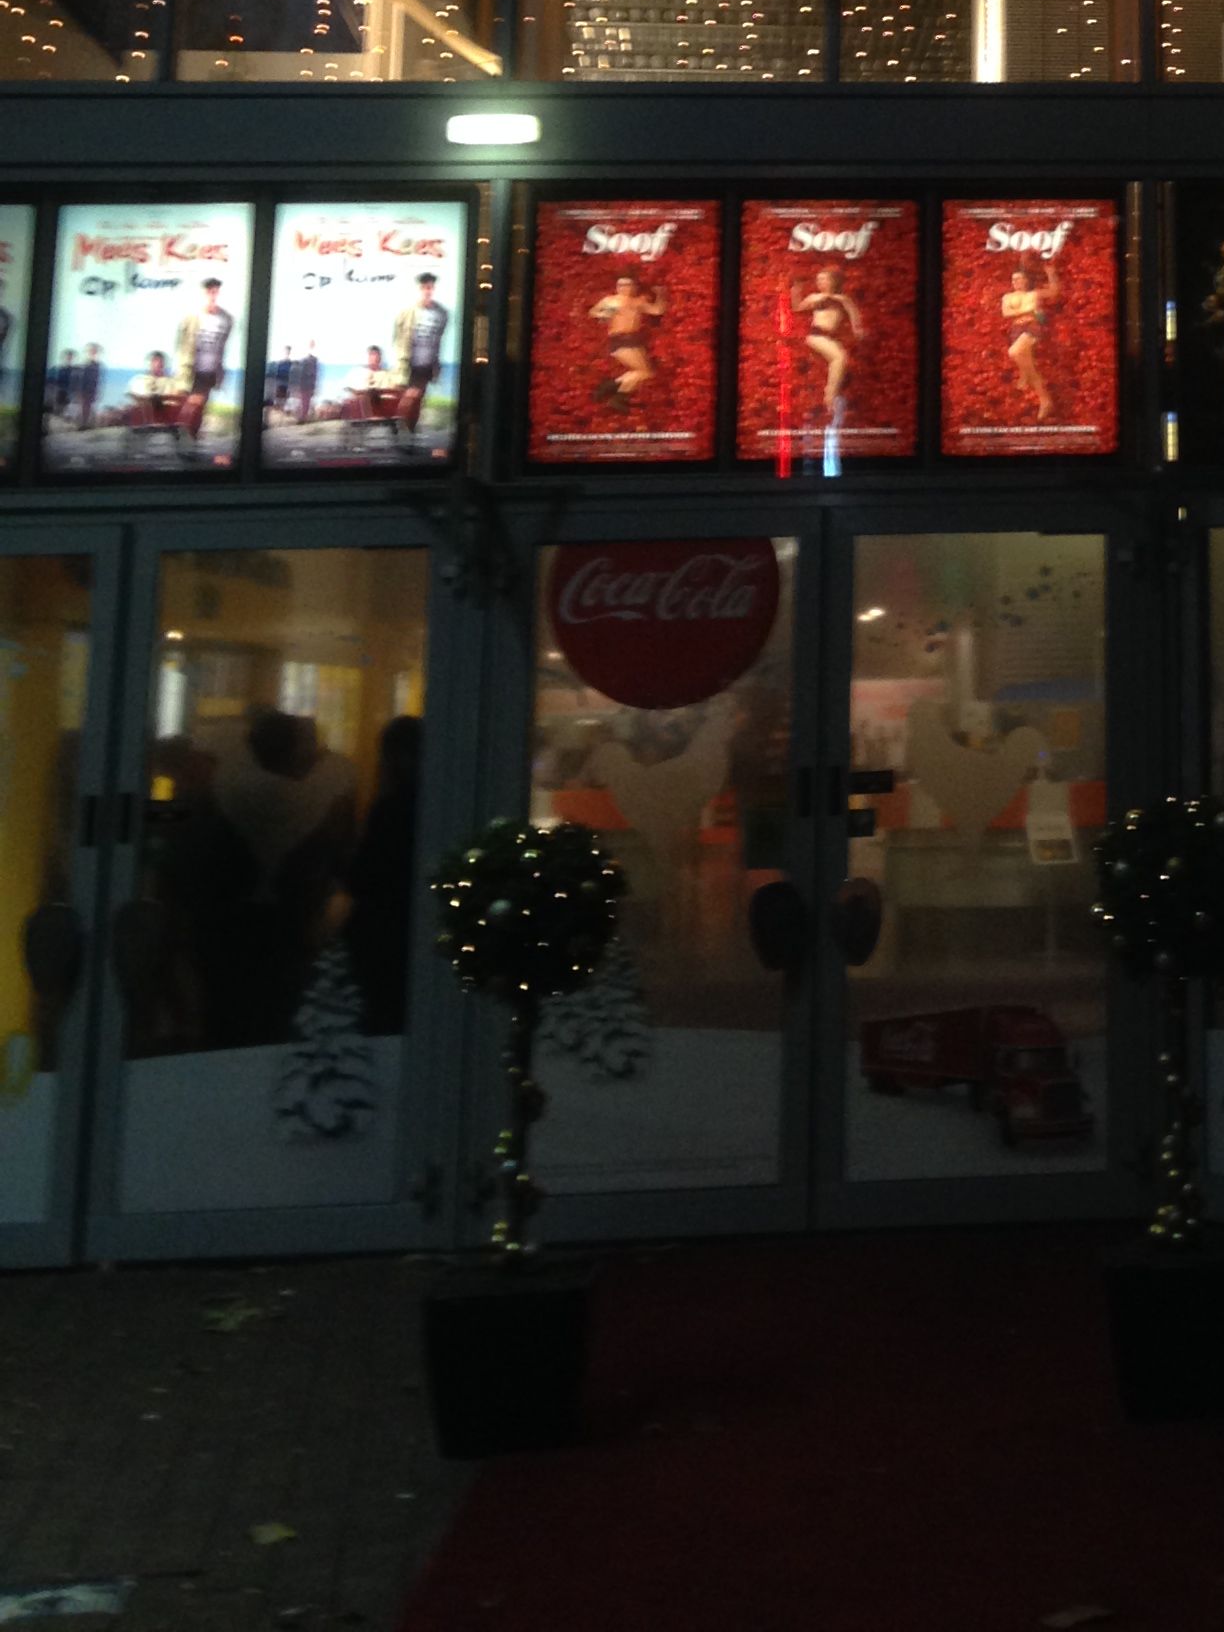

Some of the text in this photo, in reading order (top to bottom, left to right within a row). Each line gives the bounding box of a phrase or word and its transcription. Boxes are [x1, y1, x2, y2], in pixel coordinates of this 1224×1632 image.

[581, 221, 679, 263] Soof
[788, 220, 881, 260] Soof
[985, 219, 1075, 261] Soof
